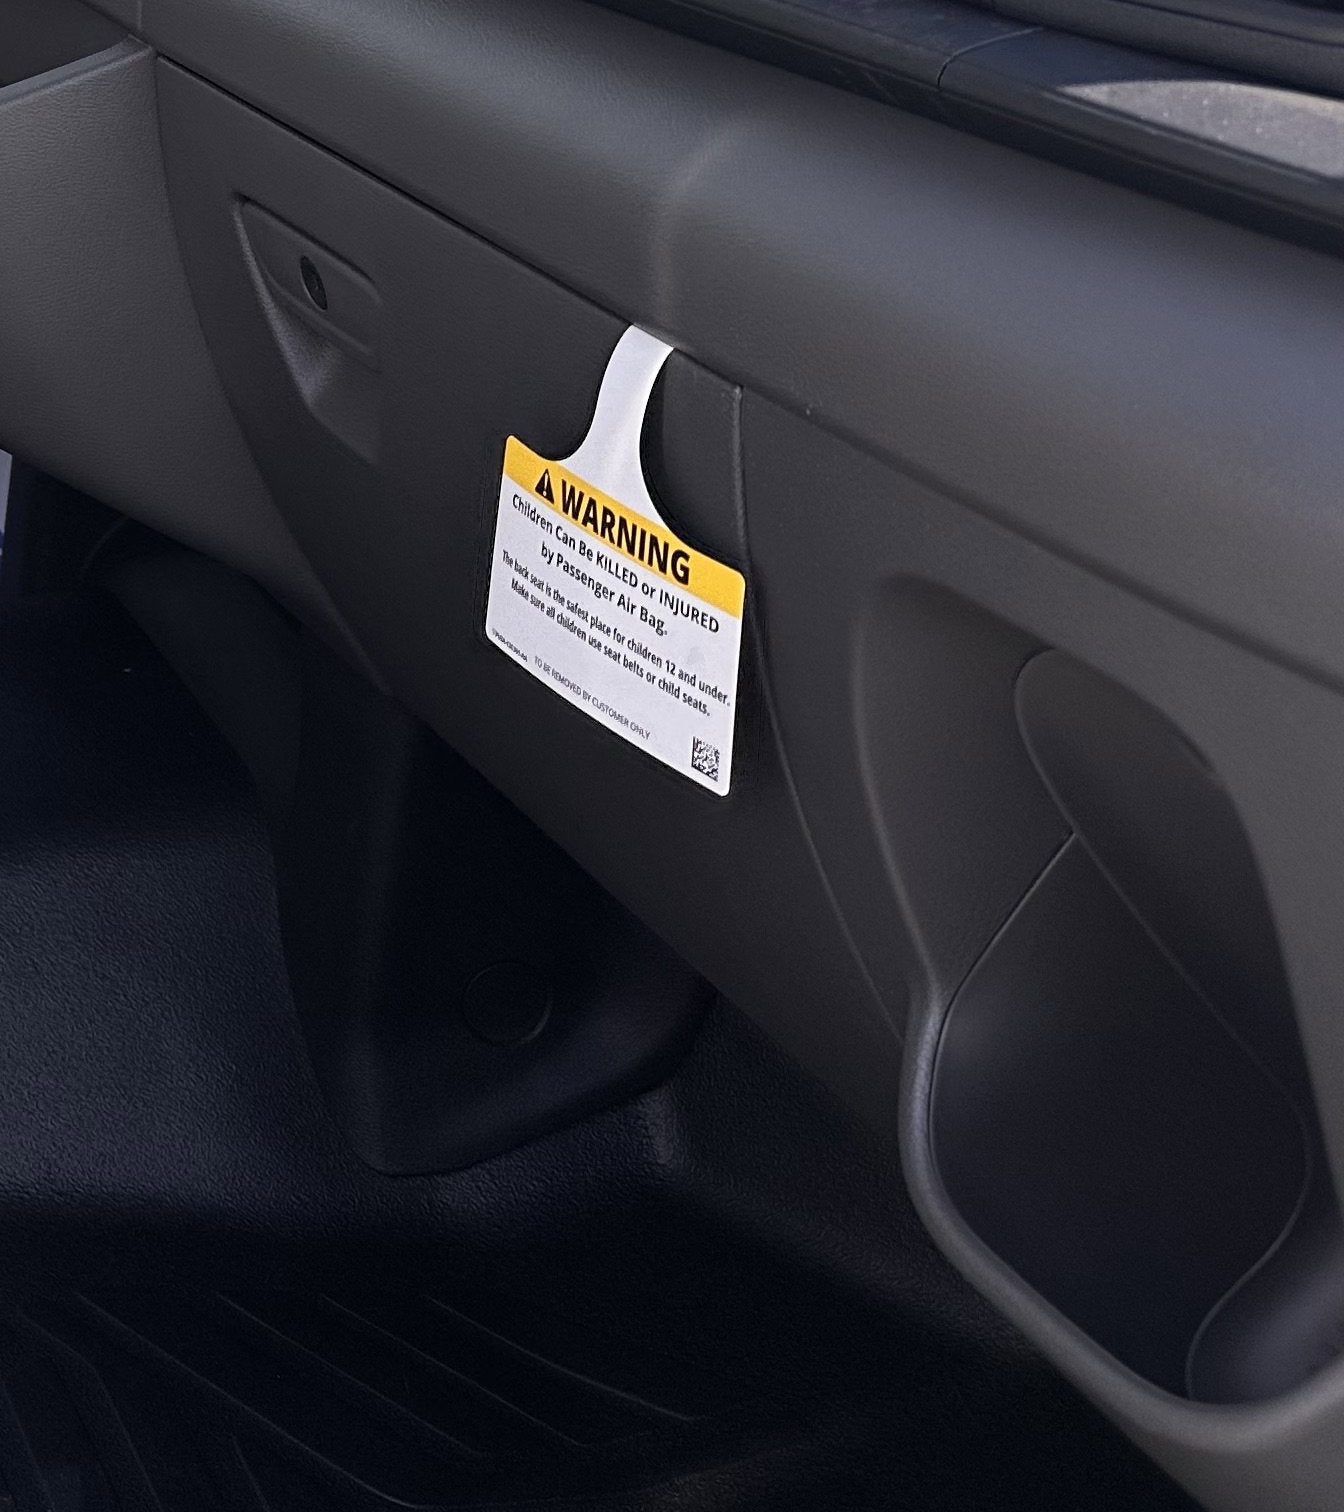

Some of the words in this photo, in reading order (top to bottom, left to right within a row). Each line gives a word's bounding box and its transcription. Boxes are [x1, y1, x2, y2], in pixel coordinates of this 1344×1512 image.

[512, 493, 553, 535] Children
[555, 525, 576, 551] Can
[578, 540, 594, 562] Be
[596, 550, 638, 588] KILLED
[641, 582, 657, 599] or
[659, 589, 720, 633] INJURED
[541, 541, 555, 565] by
[556, 552, 616, 602] Passenger
[616, 593, 637, 615] Air
[639, 605, 668, 637] Bag.
[561, 478, 691, 586] WARNING
[502, 549, 514, 569] The
[513, 558, 529, 580] back
[529, 573, 545, 593] seat
[545, 582, 552, 597] is
[552, 588, 566, 607] the
[566, 599, 589, 623] safest
[589, 615, 612, 638] place
[613, 627, 626, 646] for
[626, 638, 663, 669] children
[665, 659, 676, 676] 12
[677, 669, 697, 688] and
[698, 680, 731, 706] under.
[511, 577, 530, 601] Make
[529, 594, 546, 613] sure
[545, 606, 556, 620] all
[556, 612, 587, 642] children
[588, 634, 603, 652] use
[603, 645, 622, 665] seat
[622, 654, 644, 678] belts
[645, 671, 657, 685] or
[657, 677, 681, 700] child
[682, 692, 710, 717] seats.
[534, 655, 543, 669] TO
